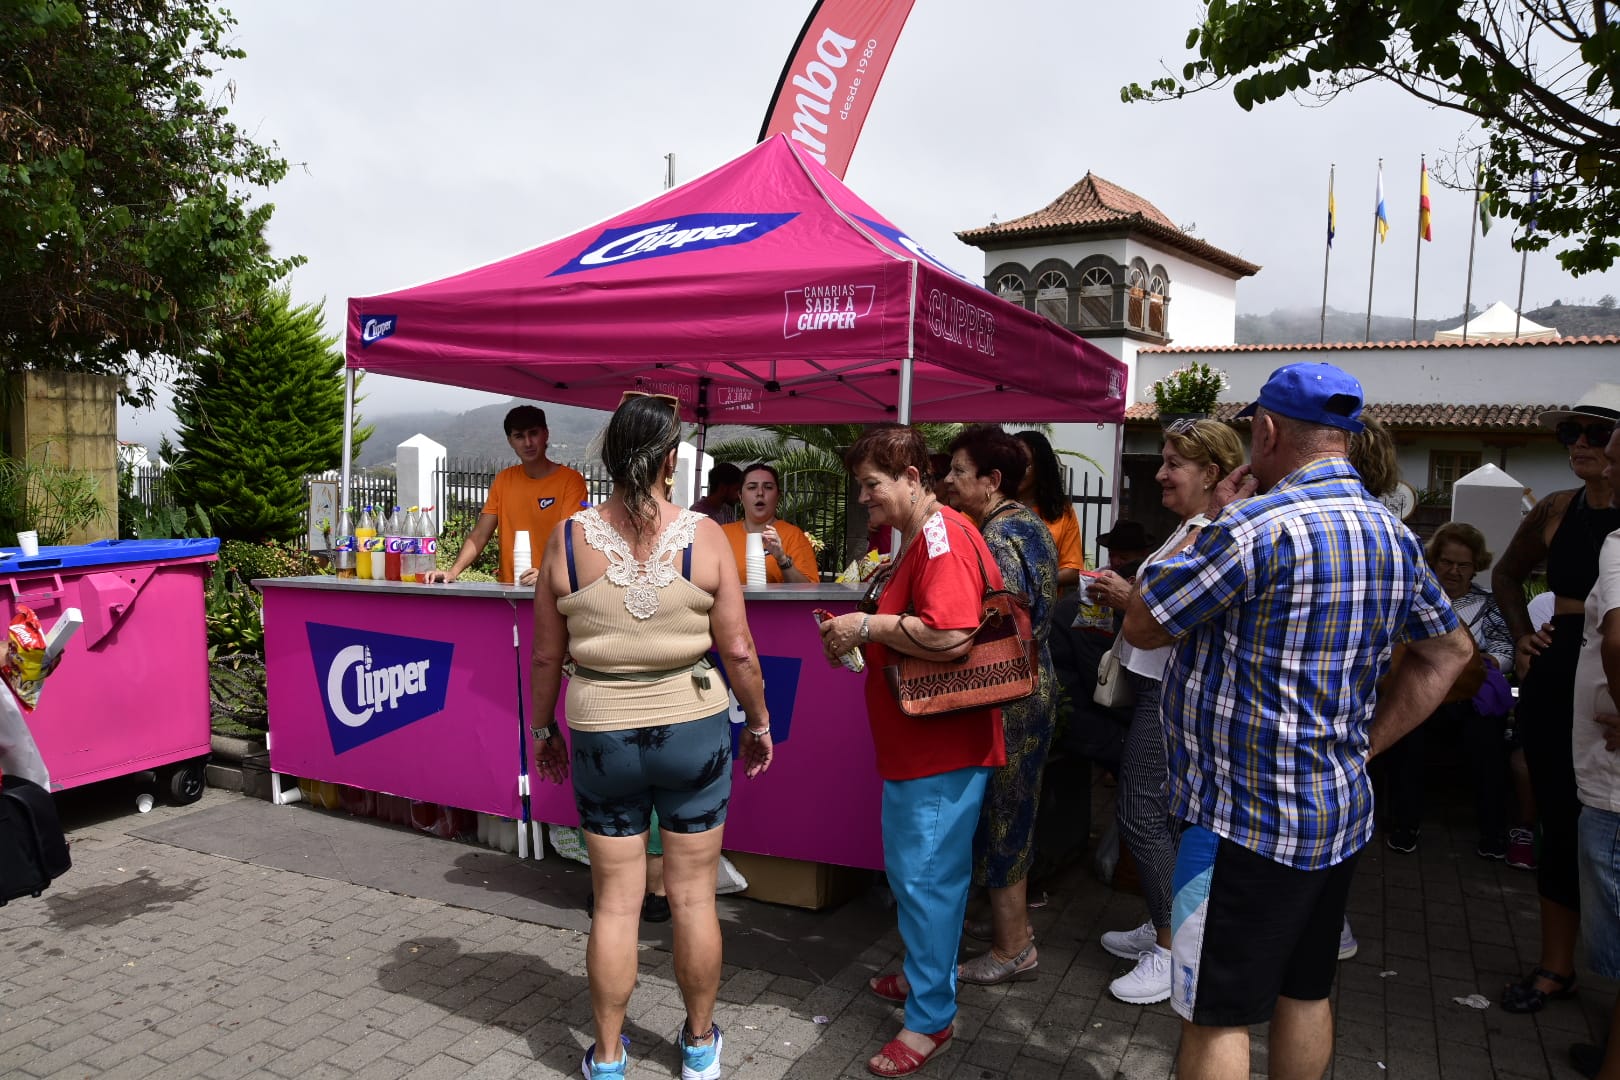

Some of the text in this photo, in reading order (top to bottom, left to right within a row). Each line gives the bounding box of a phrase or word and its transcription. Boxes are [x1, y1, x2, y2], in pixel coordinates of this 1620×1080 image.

[840, 39, 877, 121] desde 1980
[579, 222, 758, 265] Clipper
[804, 284, 855, 298] CANARIAS
[805, 296, 854, 313] SABE A
[797, 311, 857, 331] CLIPPER
[928, 288, 995, 357] CLIPPER
[327, 644, 430, 728] Clipper
